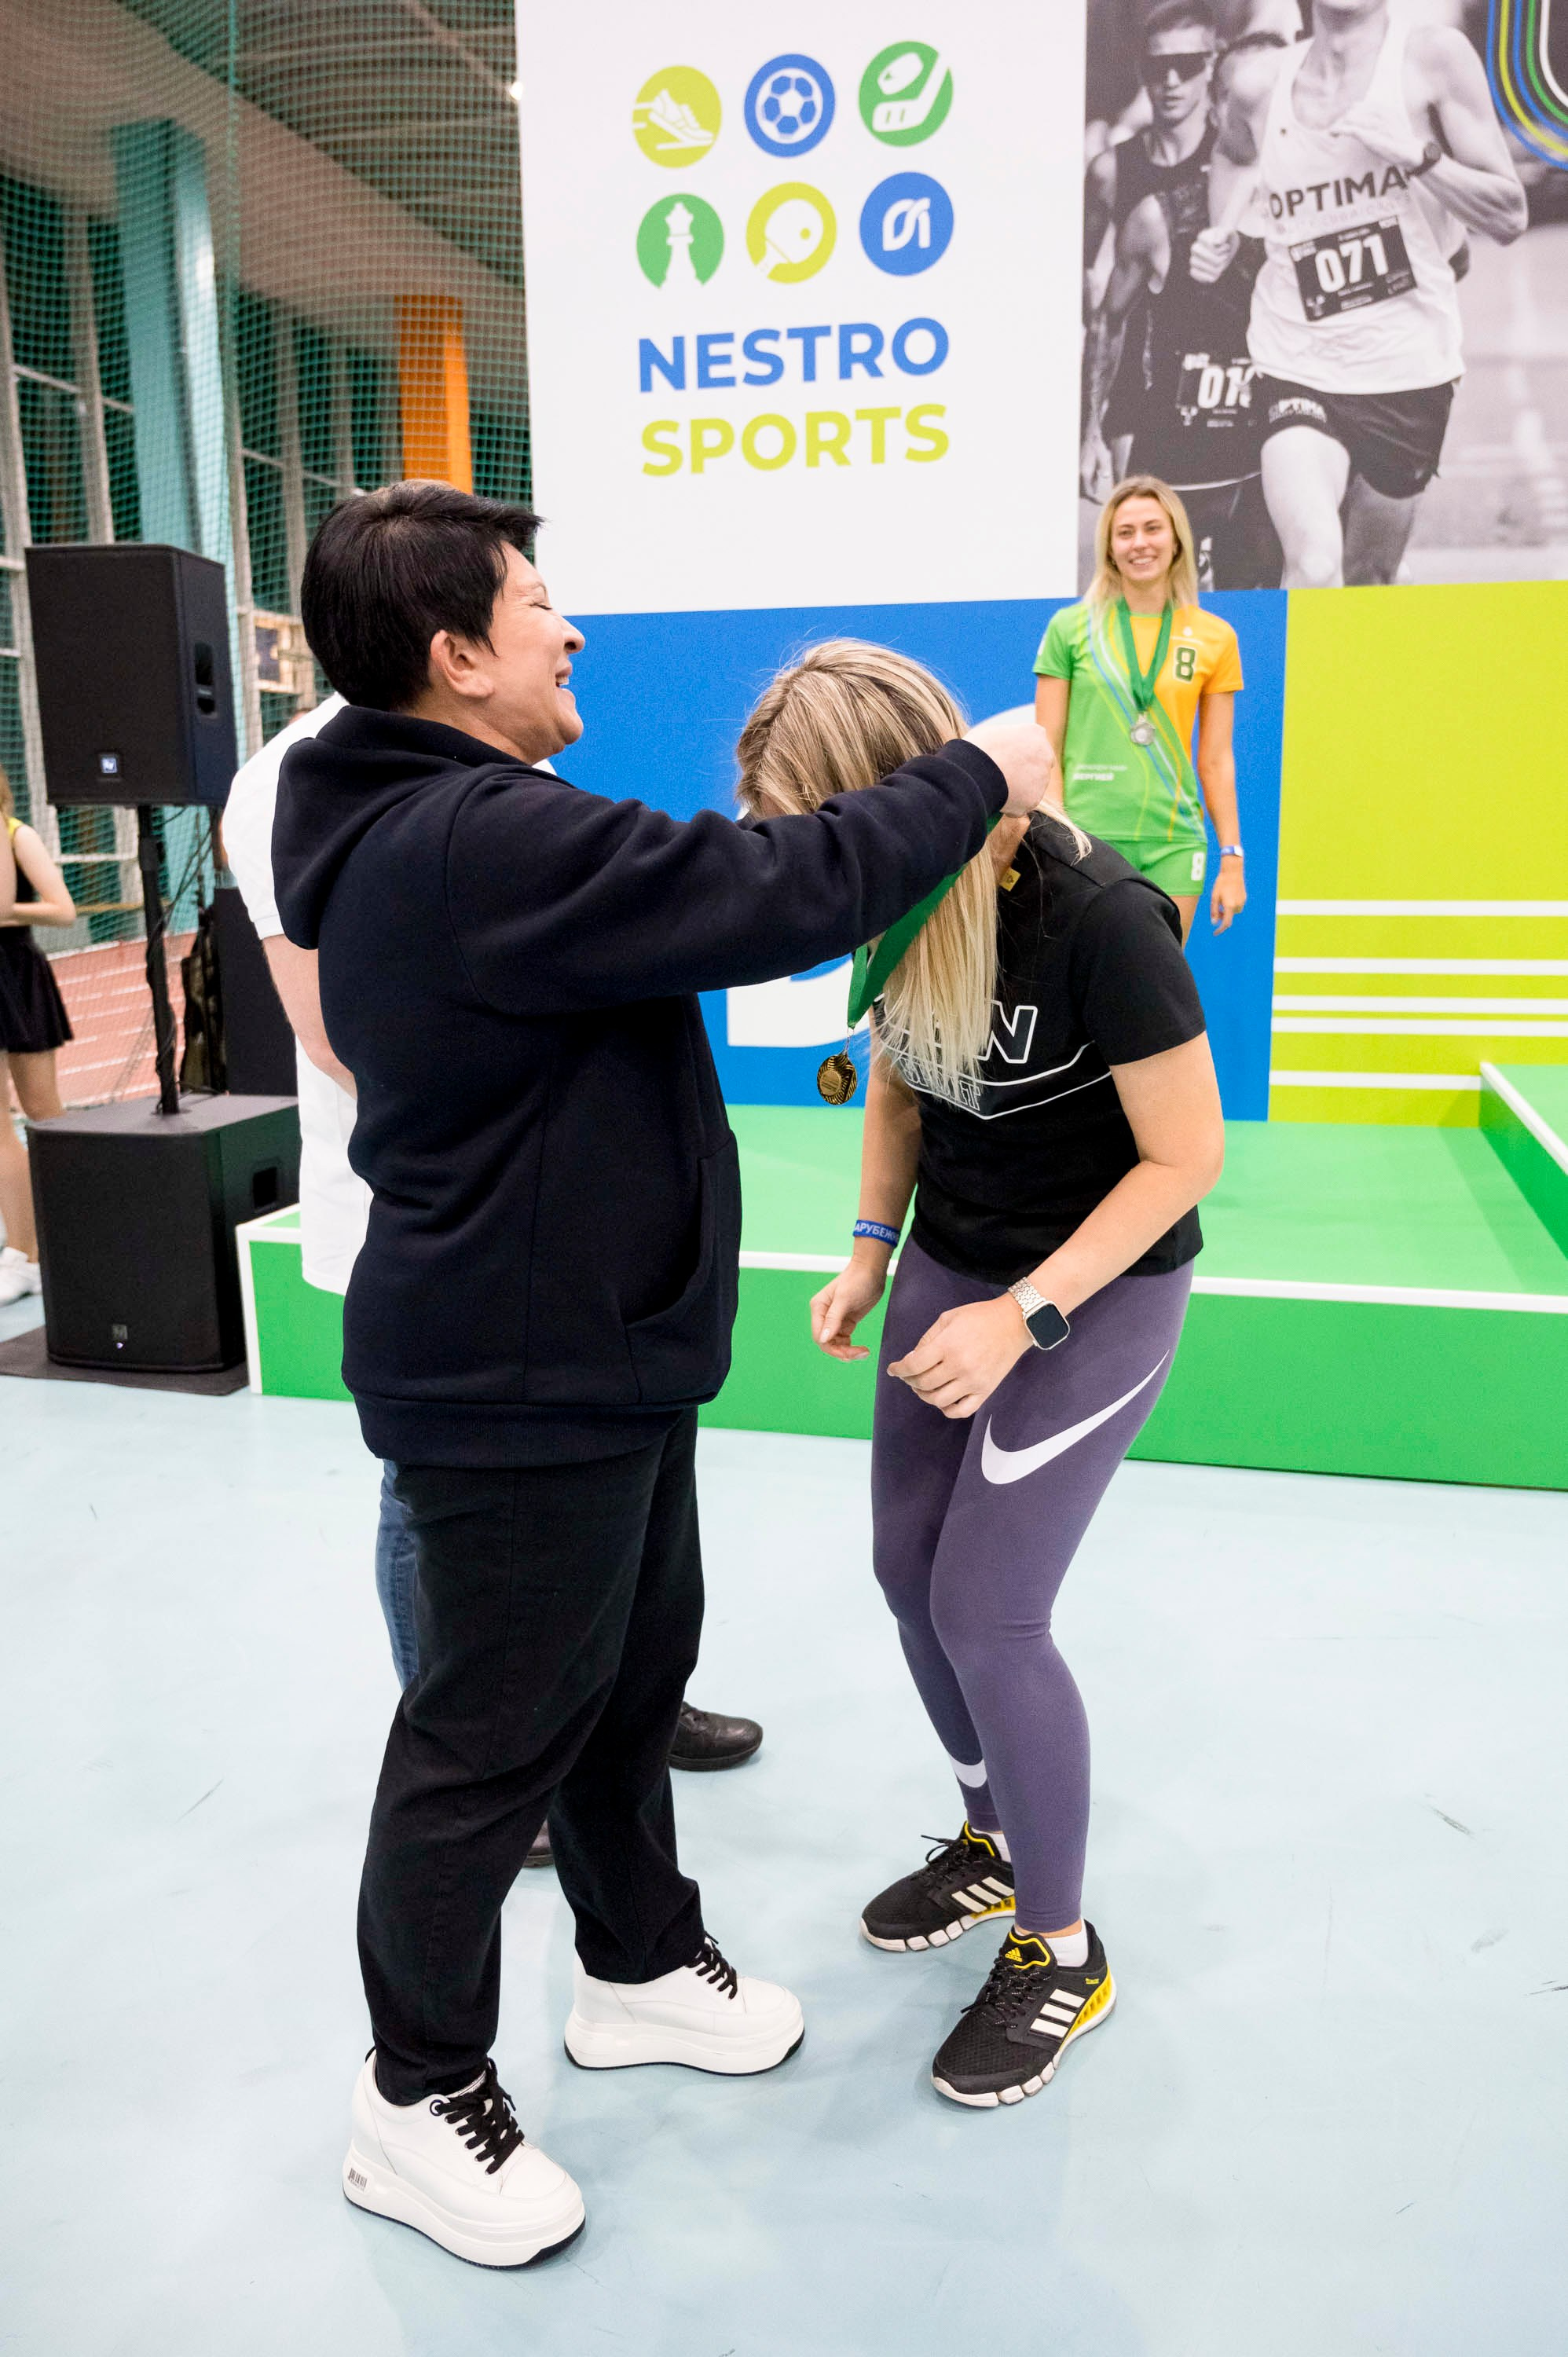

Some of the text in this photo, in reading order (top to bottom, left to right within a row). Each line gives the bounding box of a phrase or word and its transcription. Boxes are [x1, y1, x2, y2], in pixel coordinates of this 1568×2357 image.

[1269, 165, 1408, 219] OPTIMA
[1314, 233, 1389, 293] 071
[639, 317, 950, 393] NESTRO
[641, 403, 950, 477] SPORTS
[1174, 646, 1196, 684] 8
[1191, 852, 1205, 881] 8
